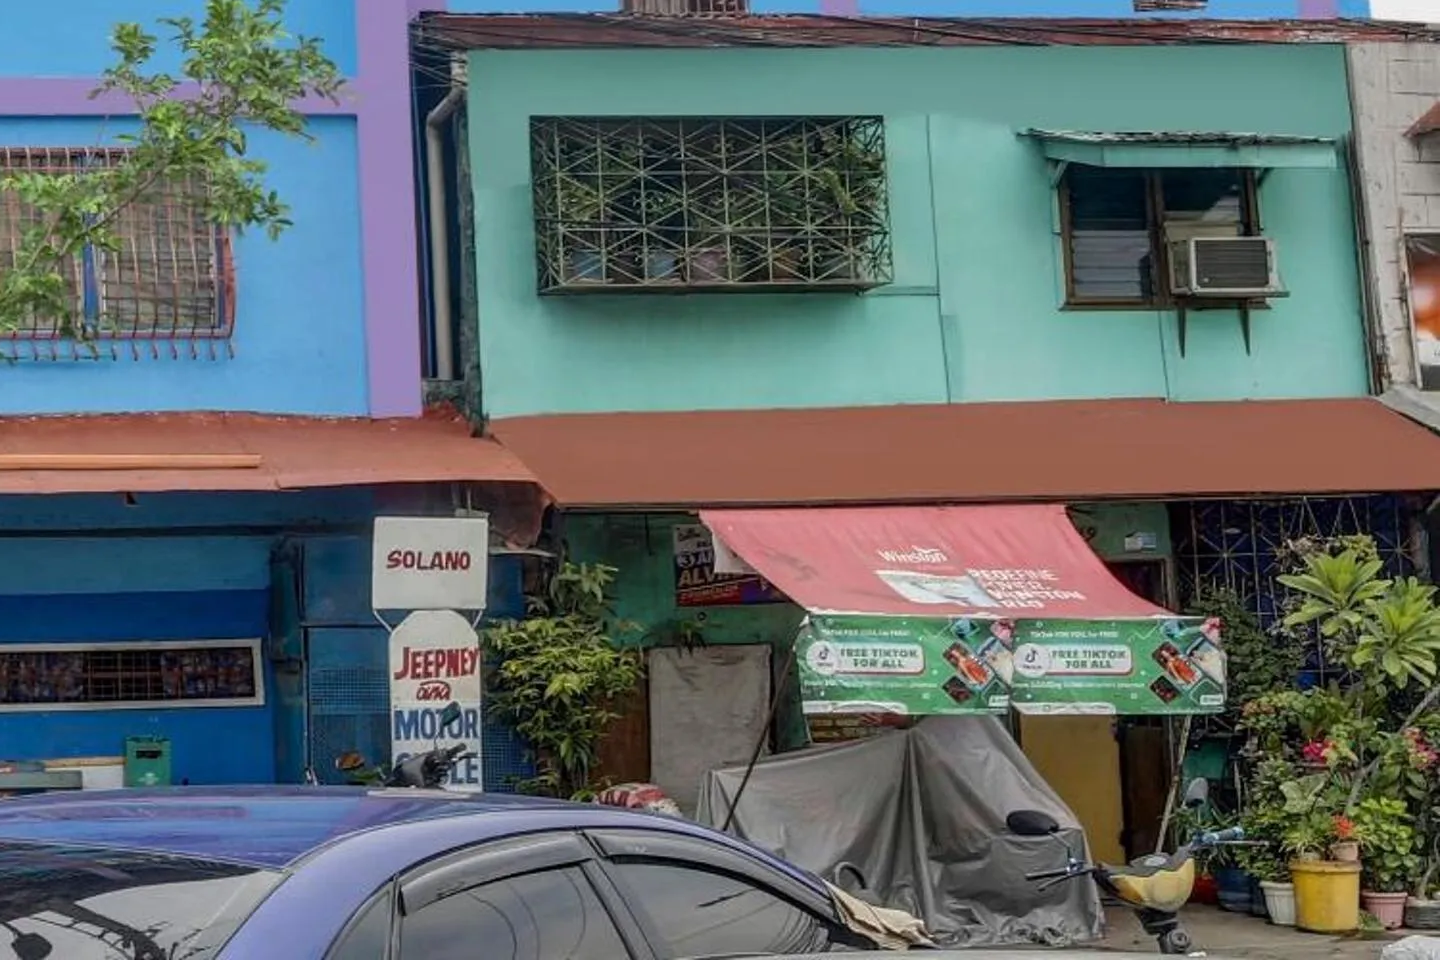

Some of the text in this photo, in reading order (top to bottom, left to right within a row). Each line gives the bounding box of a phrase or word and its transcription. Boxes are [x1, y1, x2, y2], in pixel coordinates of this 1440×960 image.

[386, 549, 471, 571] SOLANO
[878, 547, 948, 564] Winston
[393, 646, 482, 680] JEEPNEY
[394, 707, 479, 740] MOTOR
